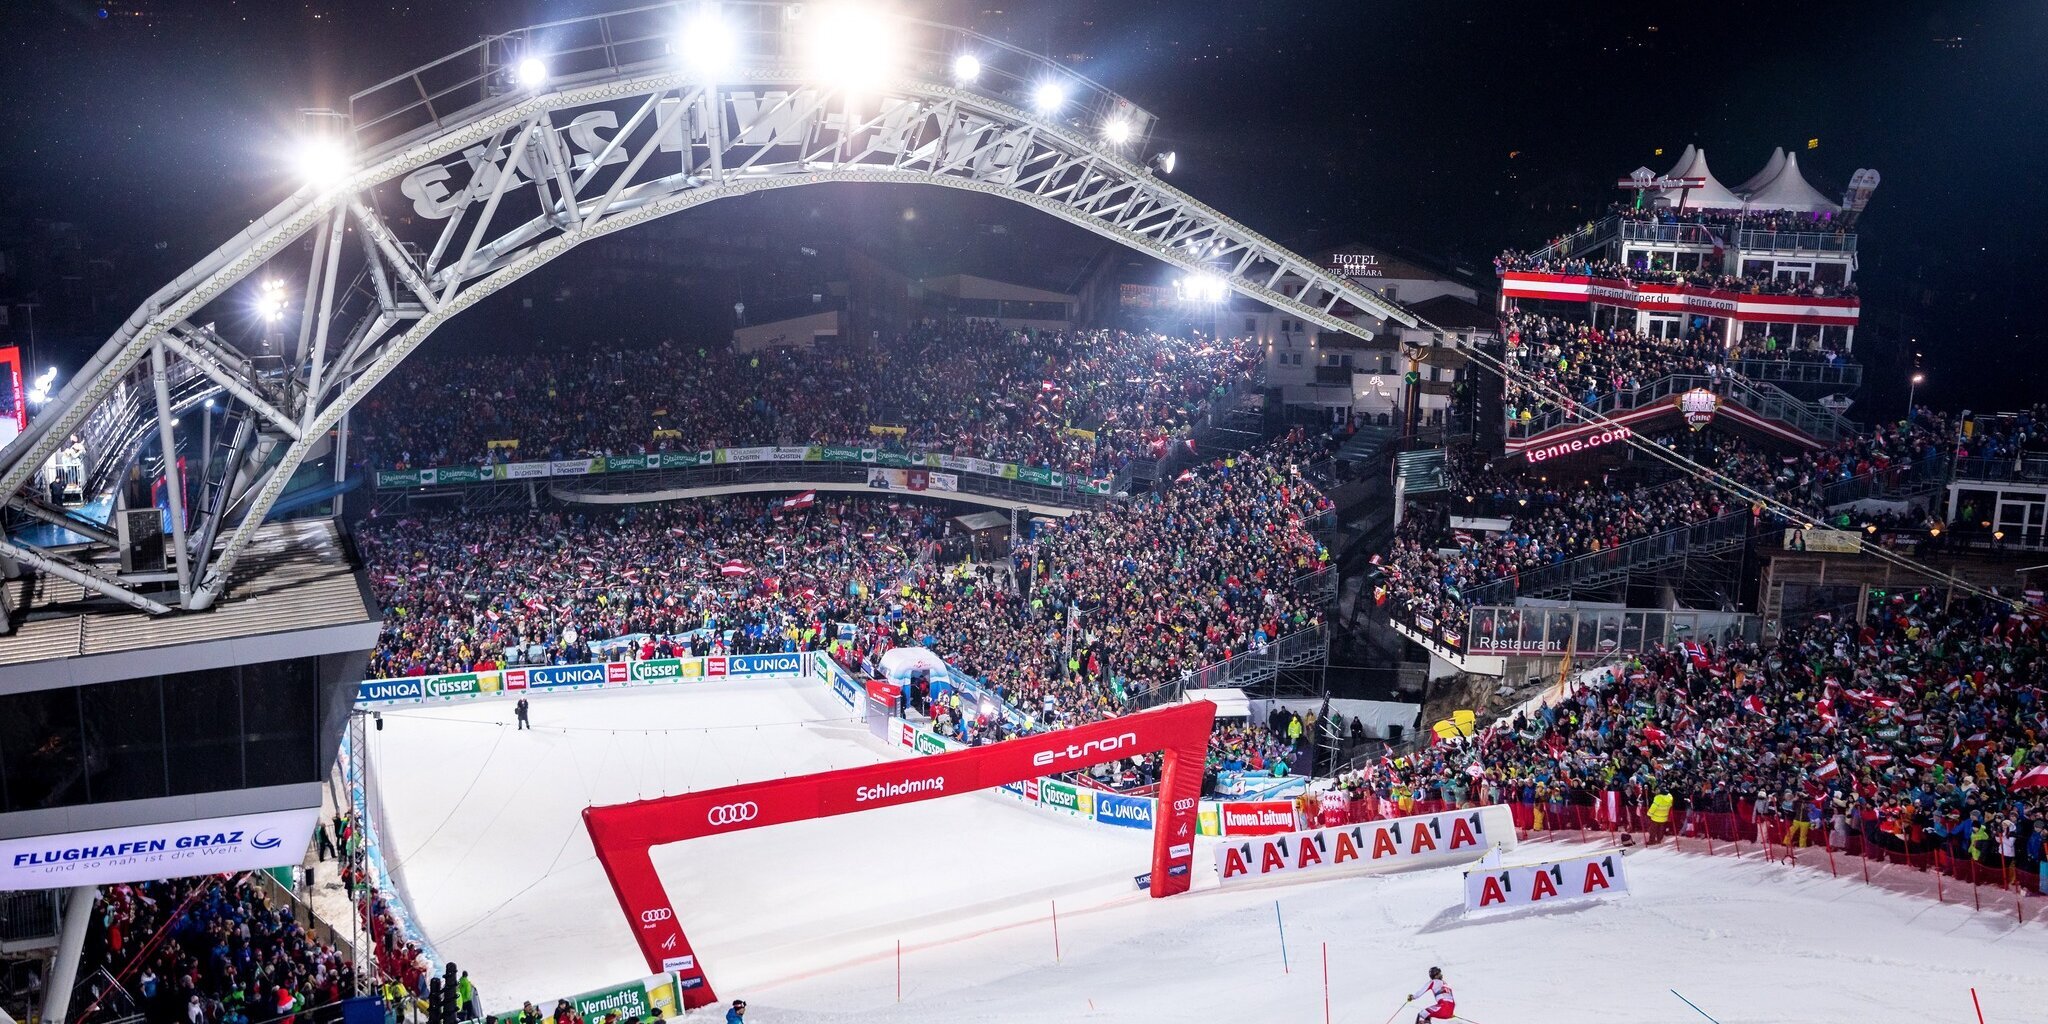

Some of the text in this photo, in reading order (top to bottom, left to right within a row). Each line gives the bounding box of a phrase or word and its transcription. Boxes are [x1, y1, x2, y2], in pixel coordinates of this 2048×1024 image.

[1332, 254, 1379, 265] HOTEL
[1344, 268, 1382, 277] BARBARA
[1591, 285, 1734, 310] hier sind wir per du tenne.com
[12, 371, 20, 388] Audi
[824, 448, 859, 458] Steiermark
[1526, 426, 1633, 463] tenne.com
[610, 456, 646, 469] Steiermark
[663, 453, 698, 465] Steiermark
[439, 466, 479, 480] Steiermark
[1479, 636, 1561, 651] Restaurant
[632, 661, 679, 681] Gösser
[754, 657, 799, 672] UNIQA
[555, 668, 603, 684] UNIQA
[369, 684, 420, 699] UNIQA
[426, 677, 477, 697] Gösser
[1033, 732, 1137, 767] e-tron
[856, 776, 945, 802] Schladming
[1043, 780, 1076, 807] Gösser
[1115, 805, 1150, 822] UNIQA
[1226, 811, 1258, 827] Kronen
[1257, 810, 1293, 828] Zeitung
[13, 831, 244, 866] FLUGHAFEN GRAZ
[1223, 812, 1483, 878] A1 A1 A1 A1 A1 A1 A1
[45, 862, 76, 873] und
[109, 857, 137, 866] nah
[171, 850, 195, 860] die
[202, 845, 243, 856] Welt.
[1479, 855, 1615, 907] A1 A1 A1
[581, 989, 639, 1015] Vernünftig
